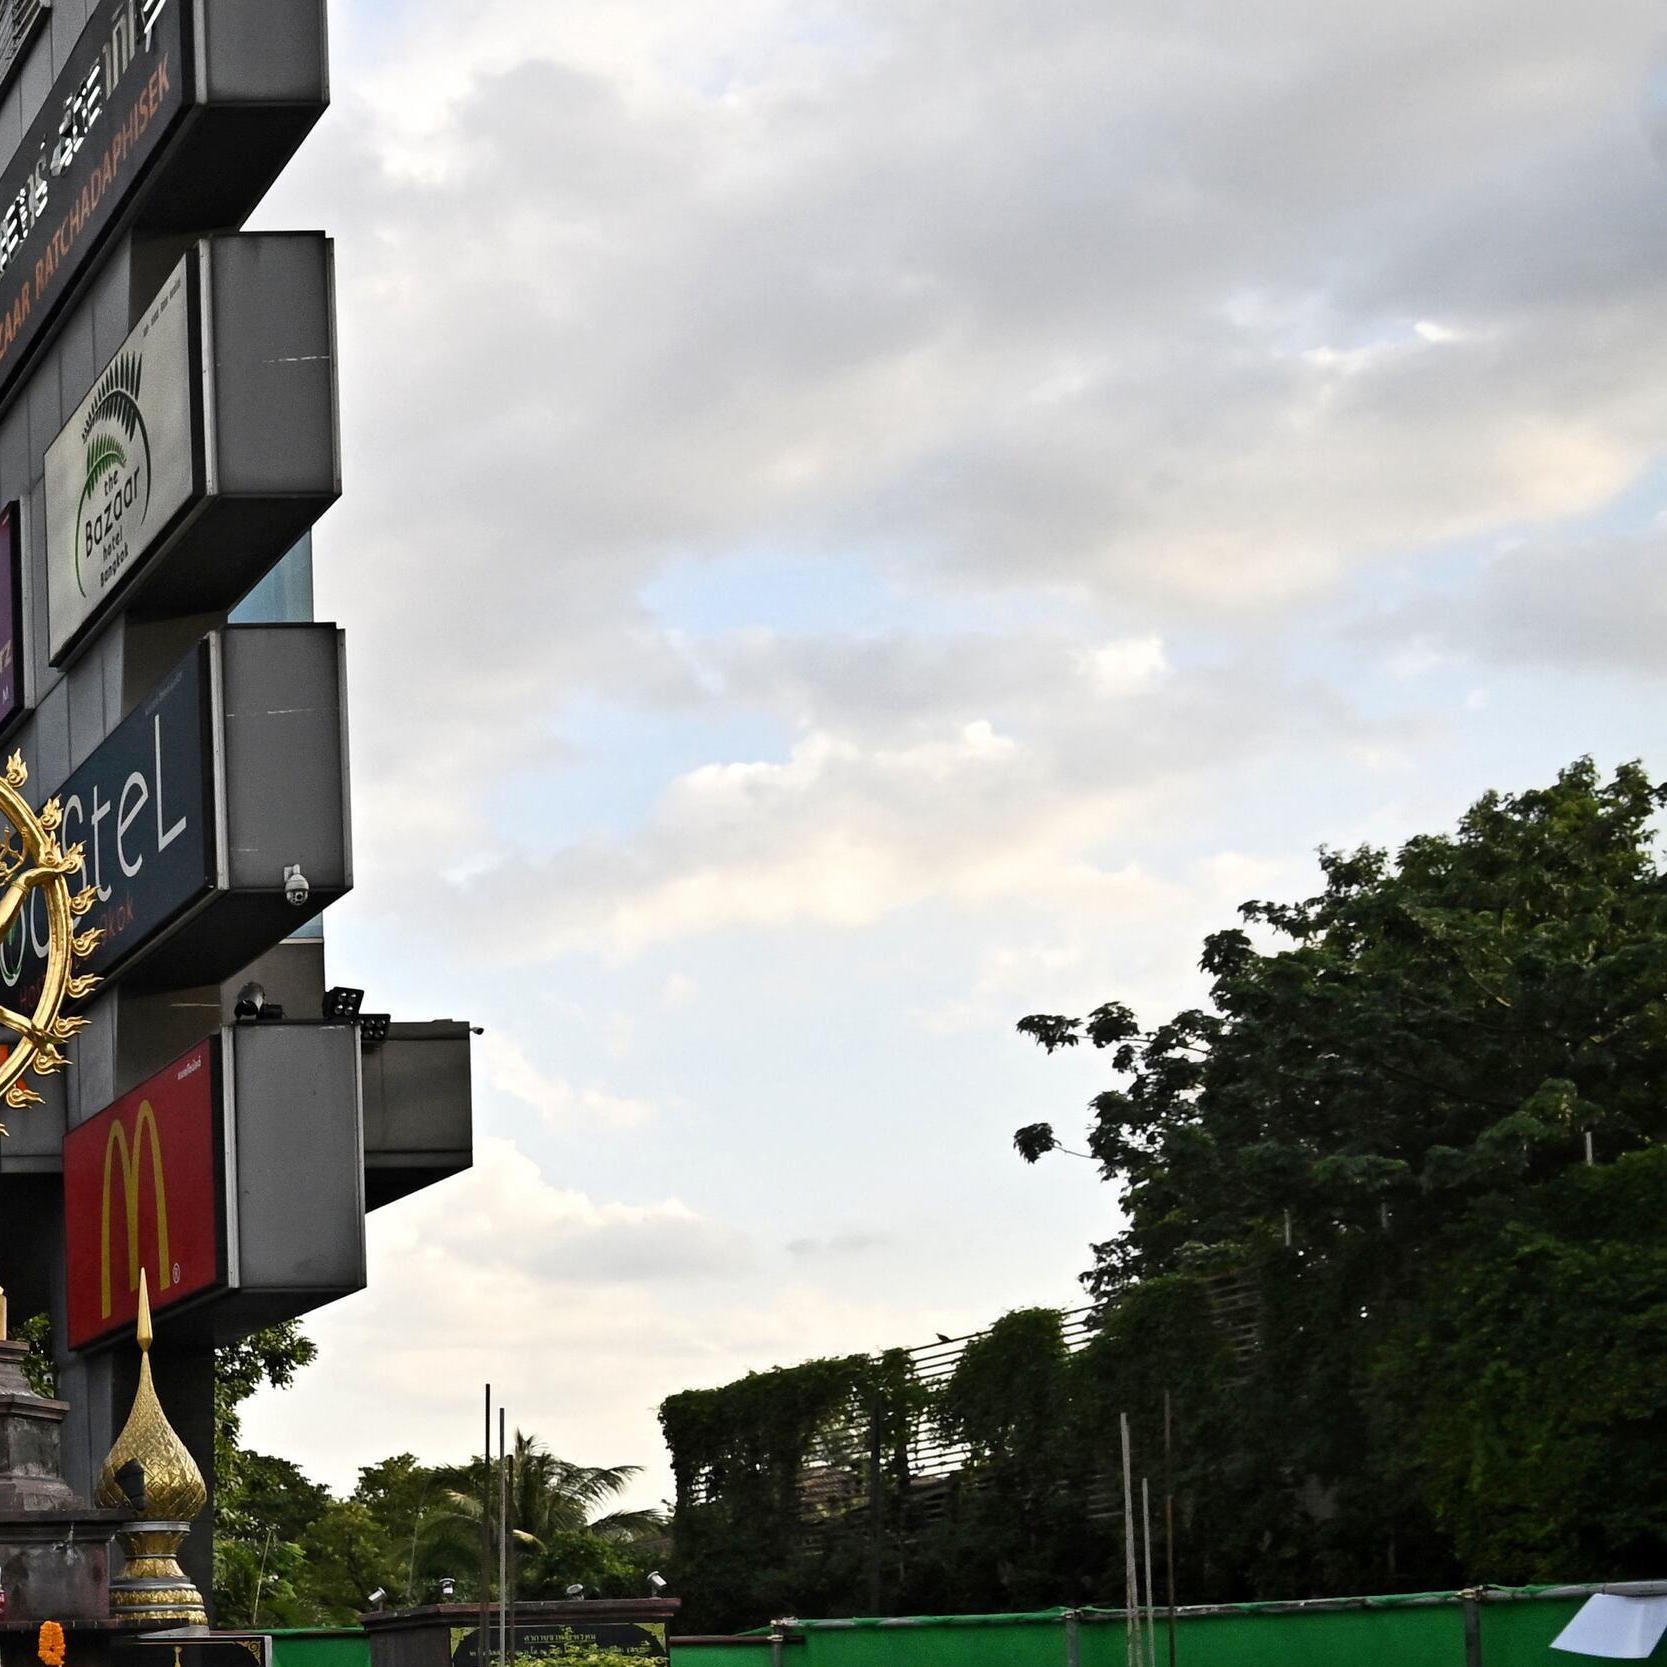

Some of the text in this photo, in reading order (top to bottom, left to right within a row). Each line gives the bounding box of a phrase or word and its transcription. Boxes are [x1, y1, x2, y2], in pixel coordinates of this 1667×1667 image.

[34, 52, 171, 302] RATCHADAPHISEK
[103, 469, 119, 497] the
[85, 465, 140, 559] Bazaar
[100, 542, 129, 587] Bangkok
[102, 525, 123, 562] hotel
